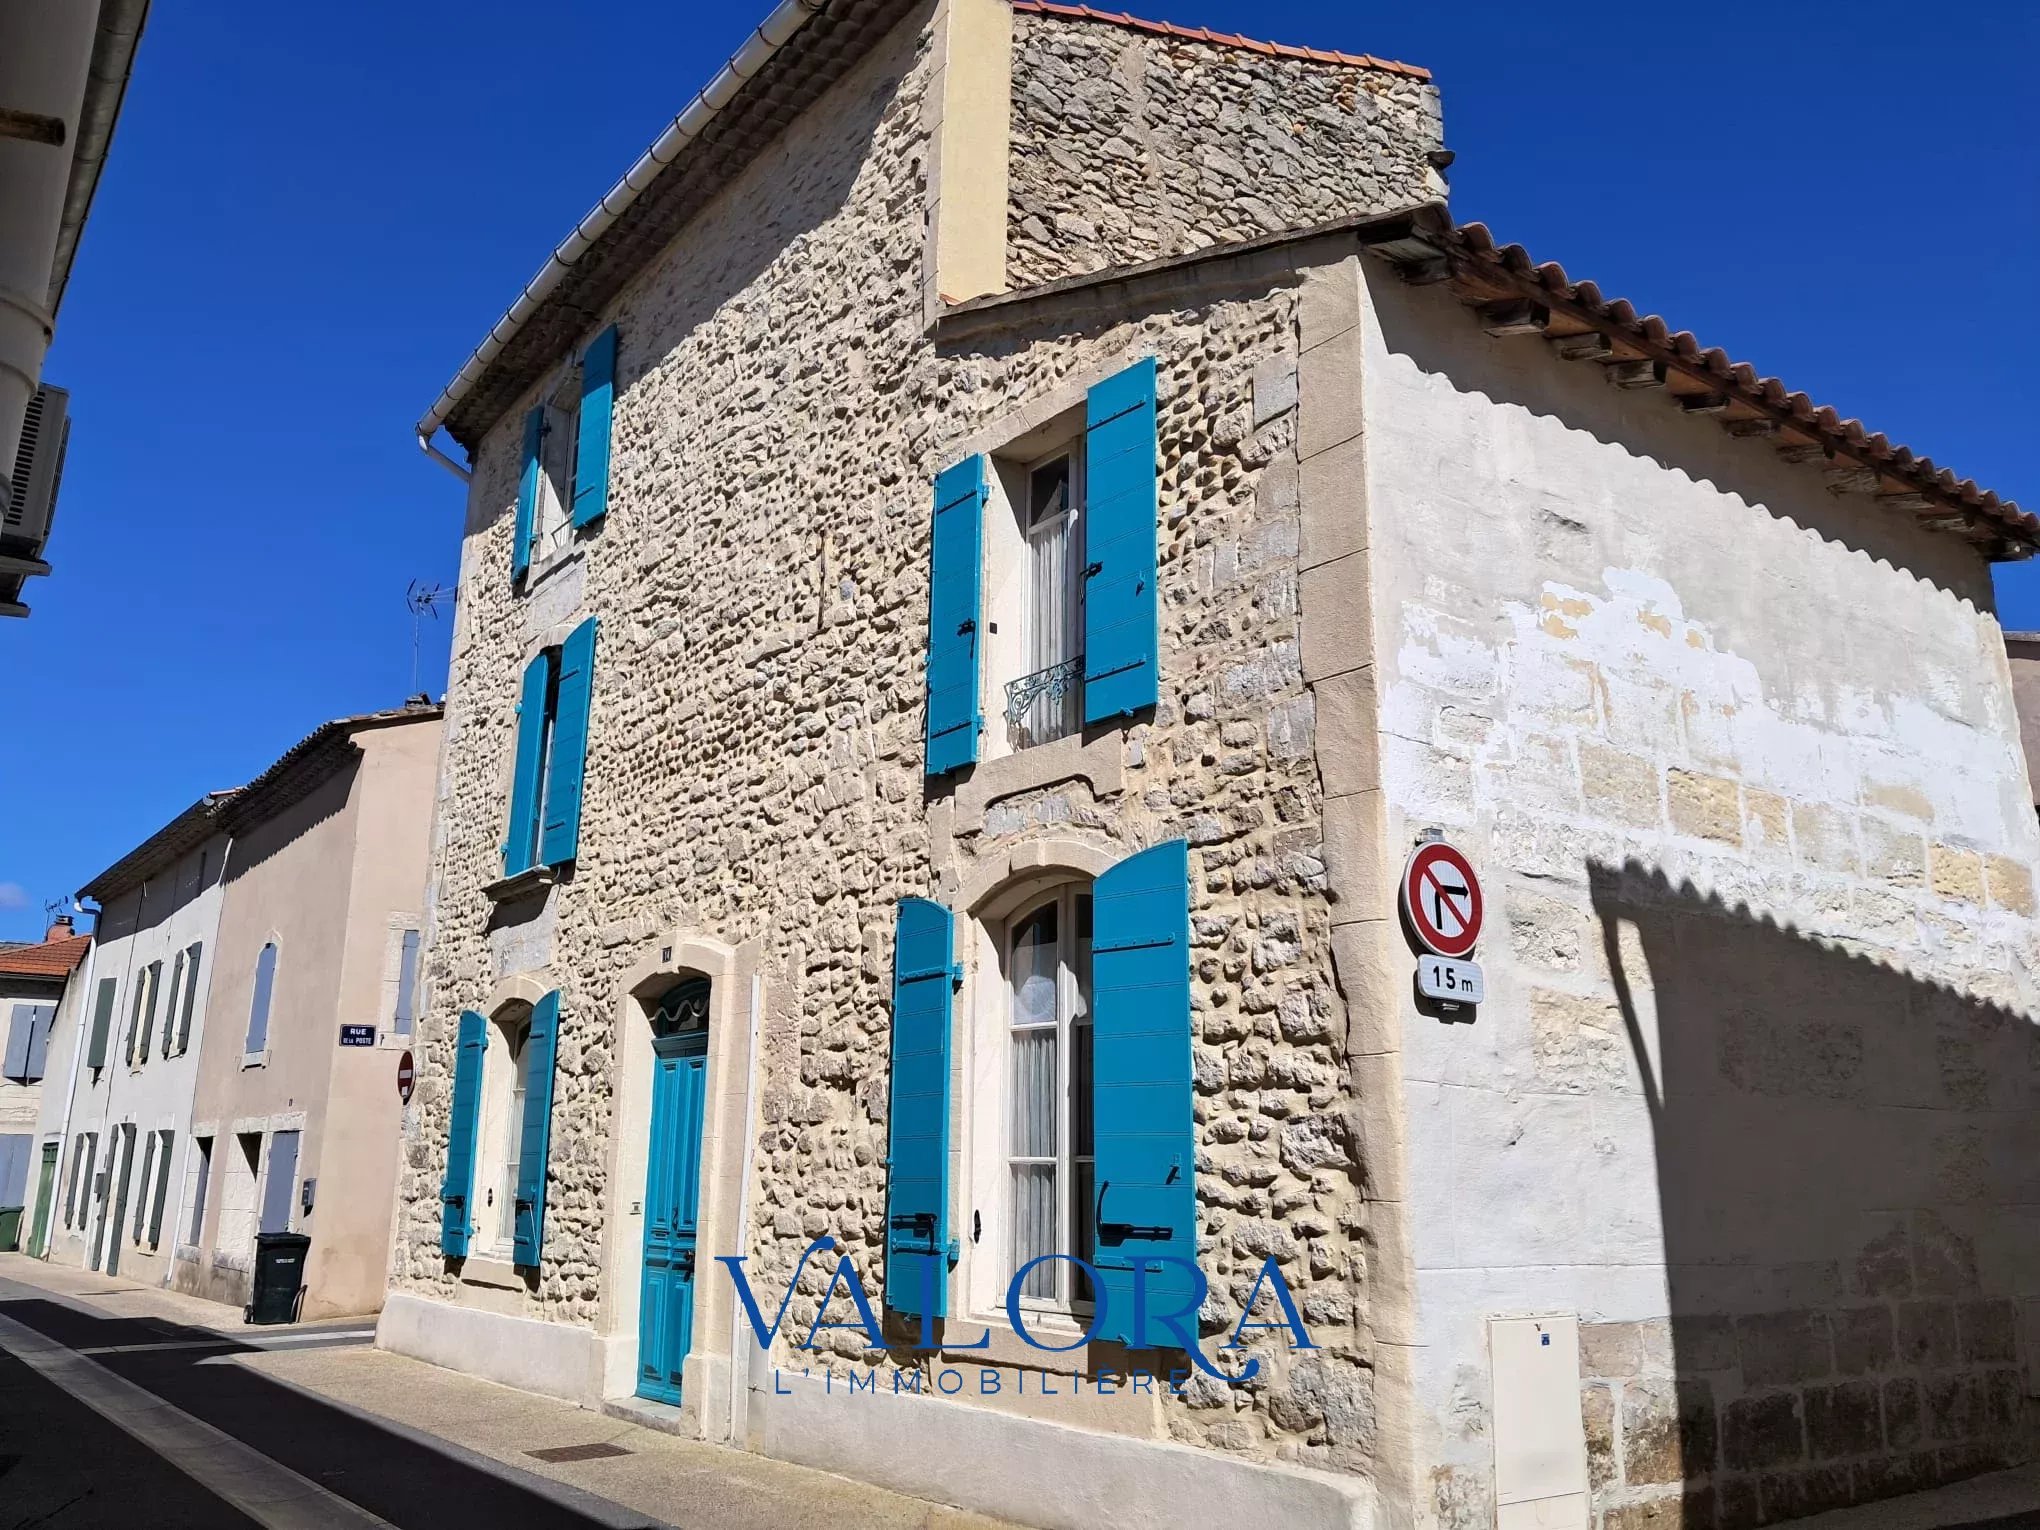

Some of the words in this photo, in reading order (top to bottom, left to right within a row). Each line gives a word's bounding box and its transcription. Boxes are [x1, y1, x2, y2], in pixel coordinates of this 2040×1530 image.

[1433, 965, 1456, 990] 15
[1461, 978, 1473, 993] m
[355, 1037, 372, 1045] POSTE
